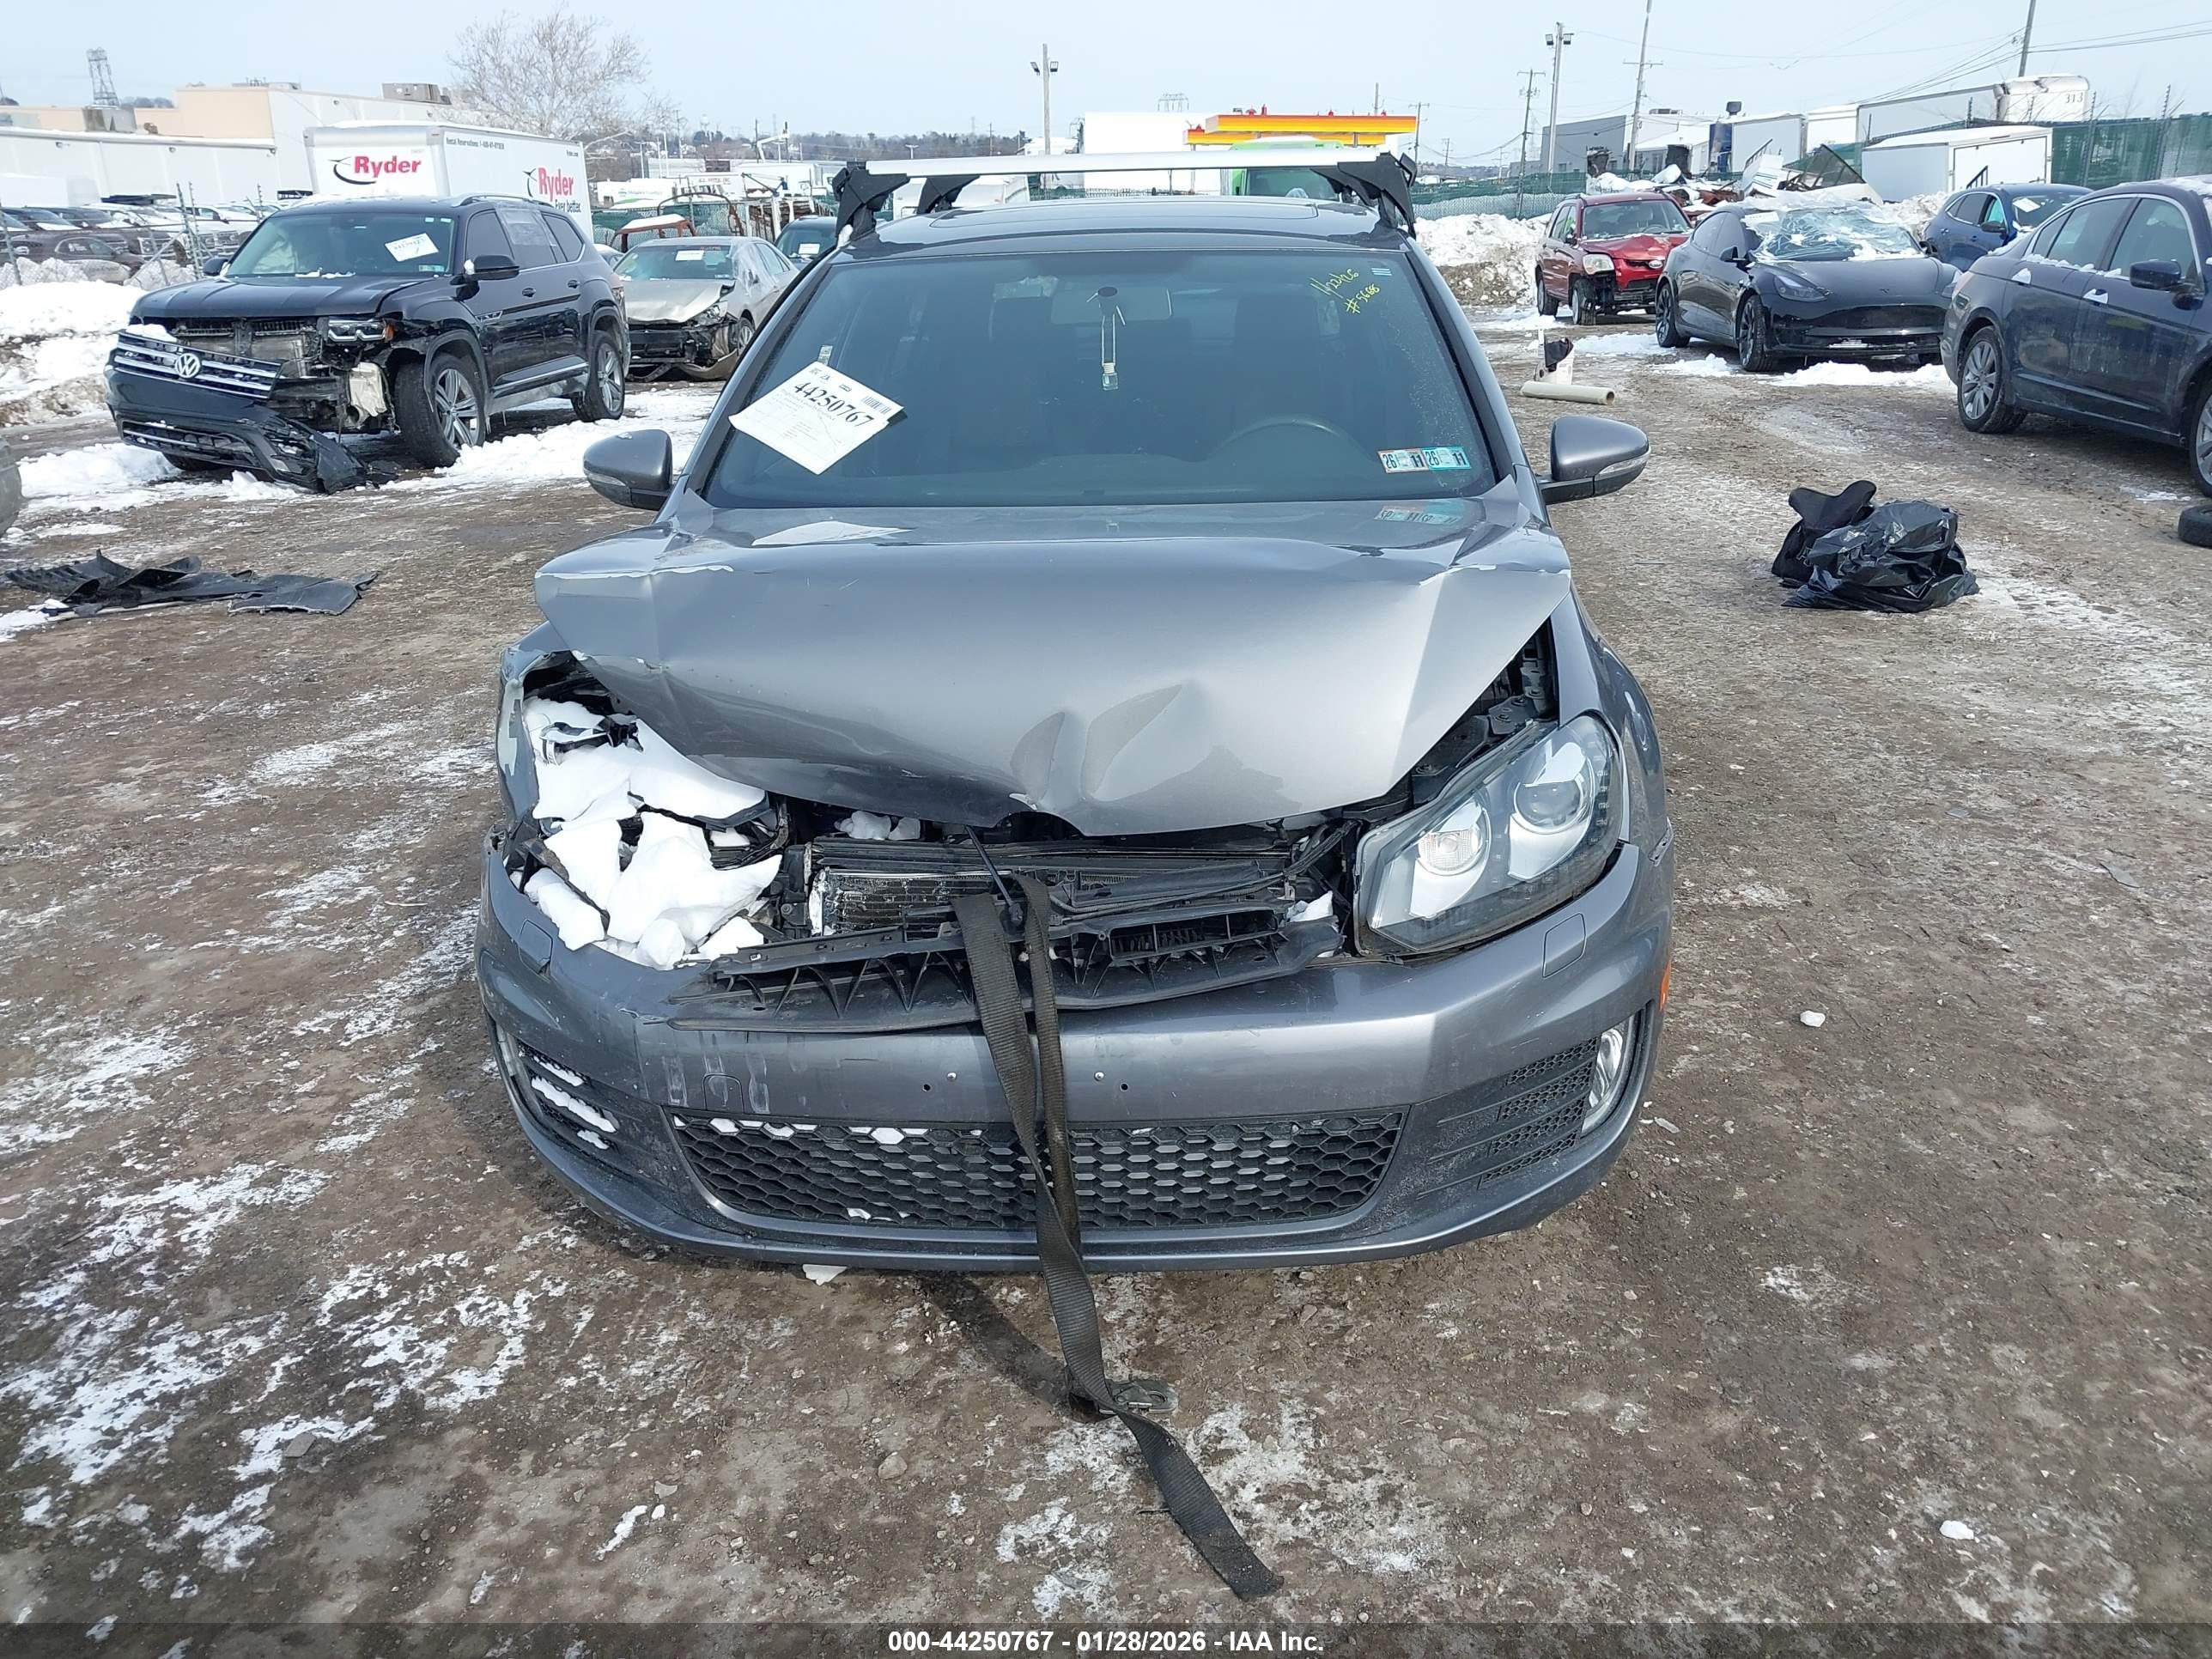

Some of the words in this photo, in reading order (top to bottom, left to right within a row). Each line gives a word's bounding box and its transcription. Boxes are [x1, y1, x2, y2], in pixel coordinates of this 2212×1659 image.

[2066, 92, 2083, 103] 313
[354, 155, 422, 179] Ryder
[538, 167, 574, 202] Ryder
[793, 382, 875, 428] 44250767
[1382, 453, 1398, 469] 26
[1410, 454, 1425, 468] 11
[1425, 451, 1440, 466] 26
[1452, 453, 1467, 465] 11
